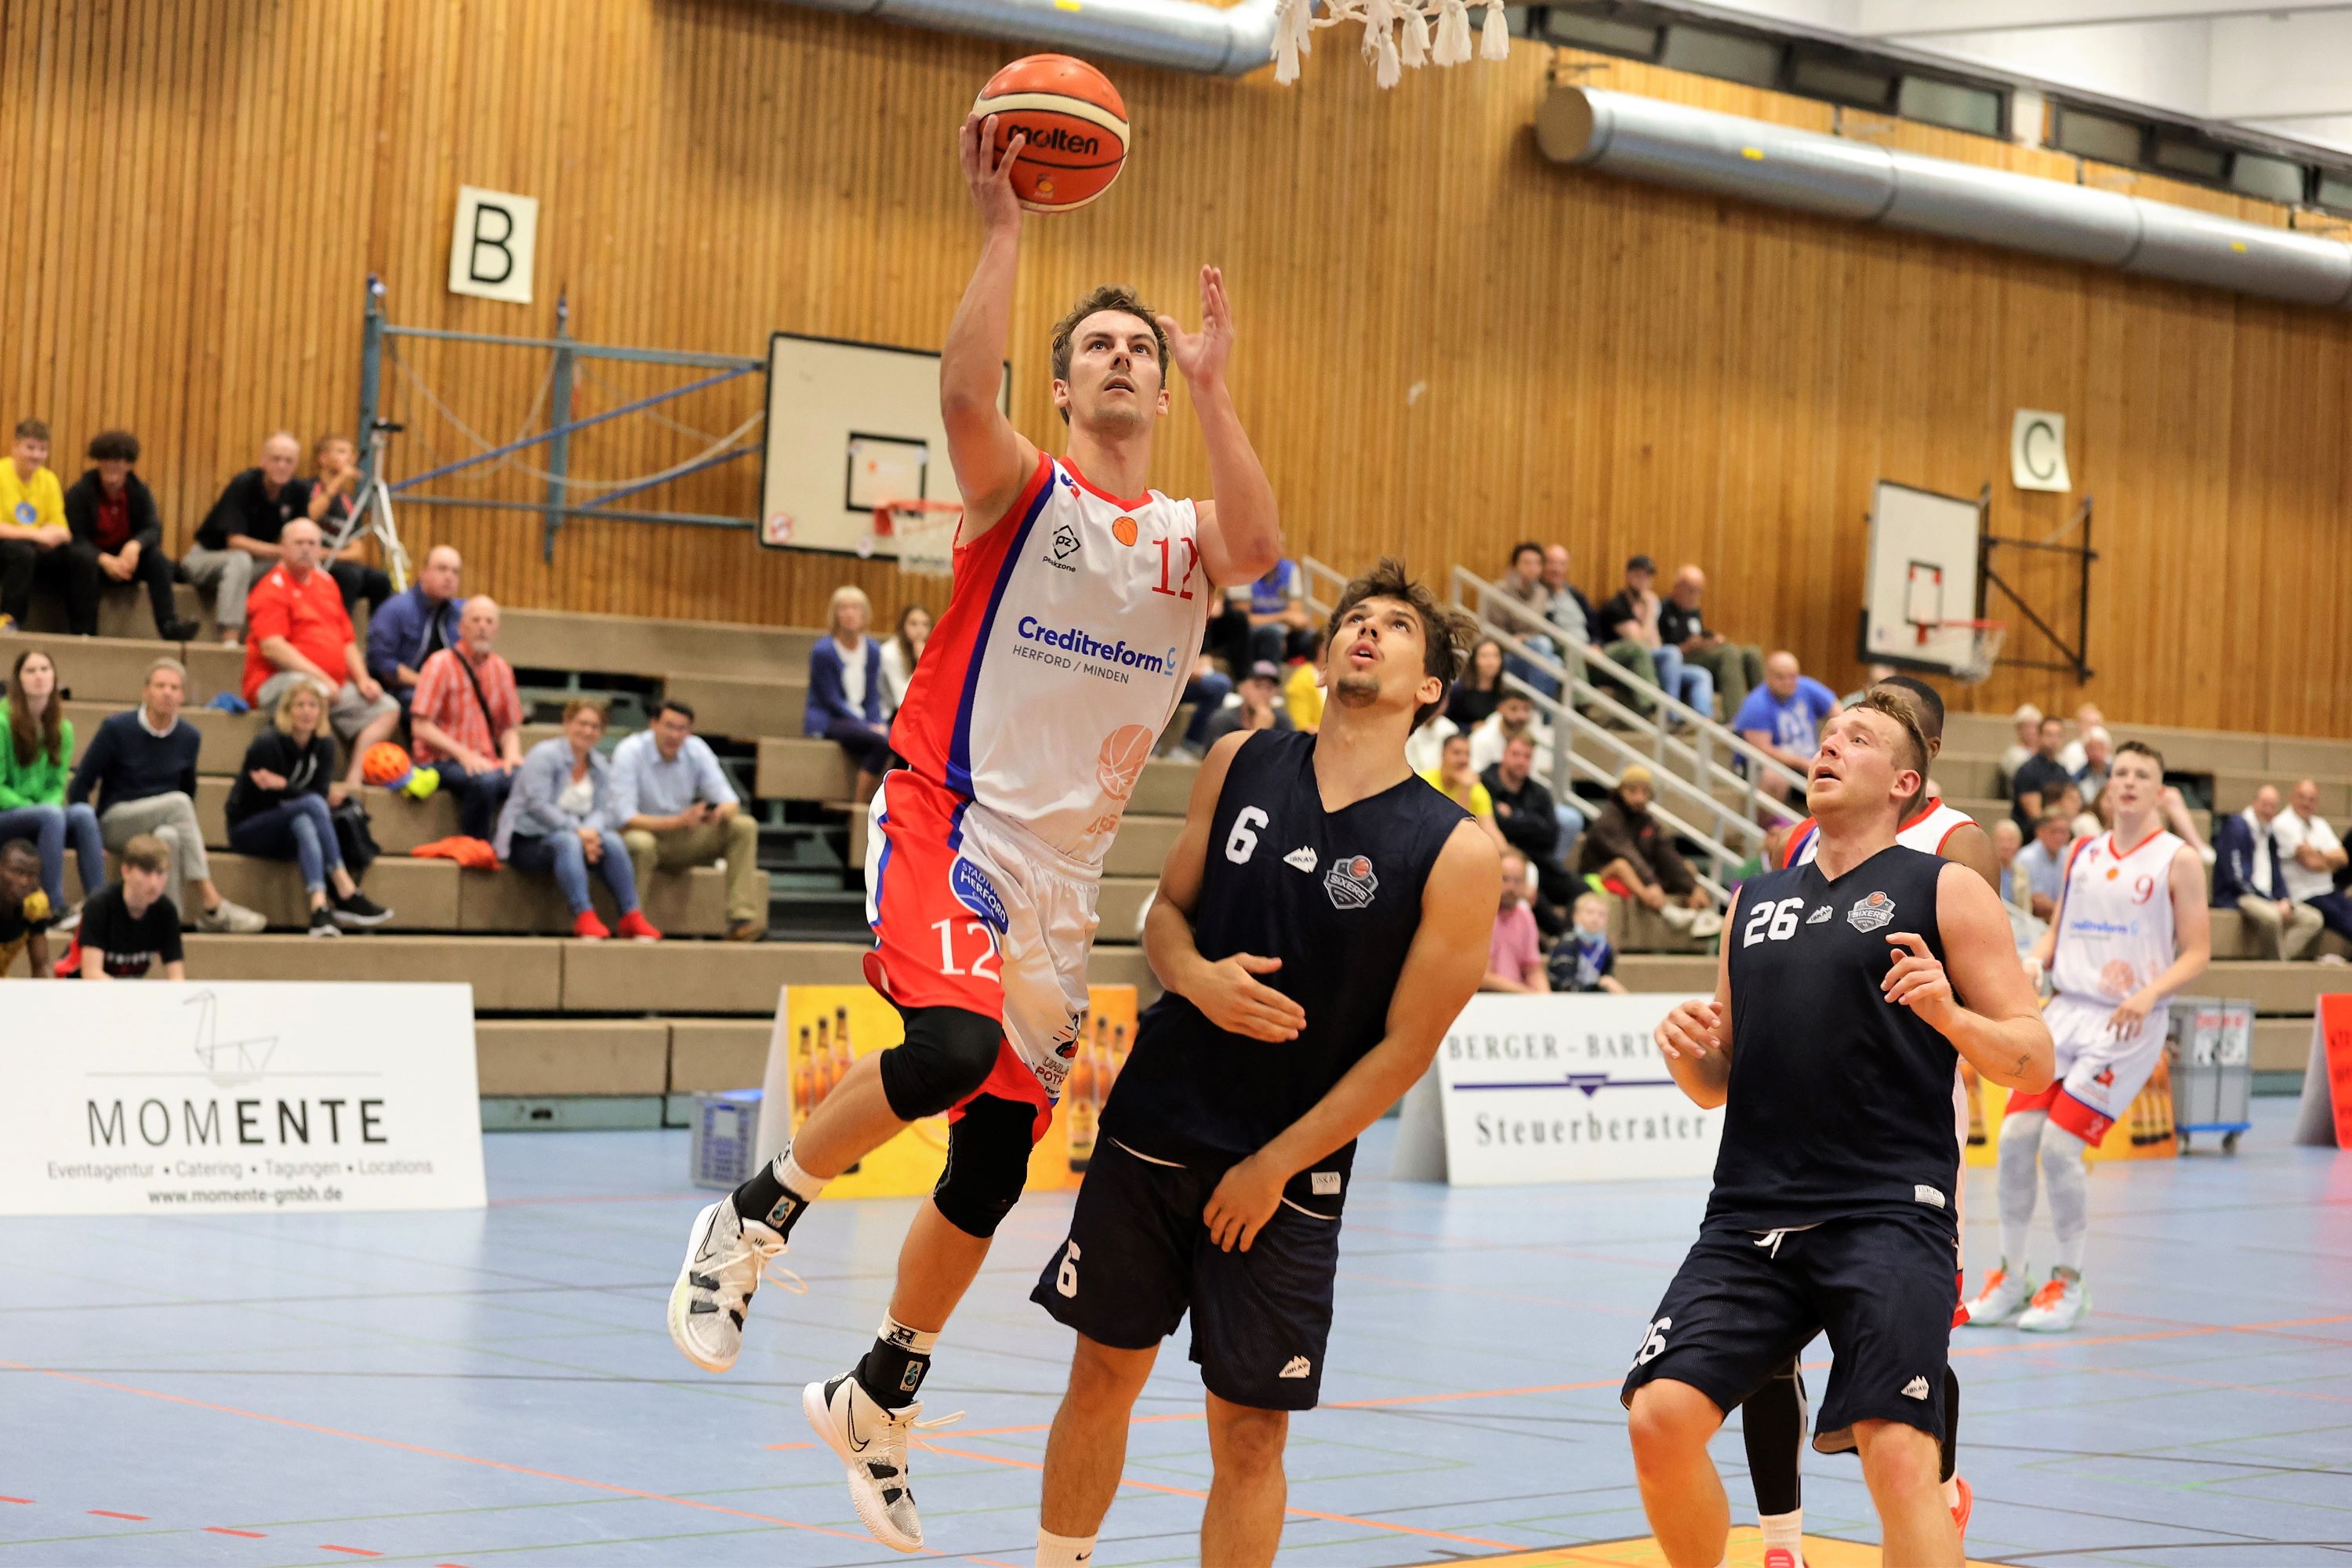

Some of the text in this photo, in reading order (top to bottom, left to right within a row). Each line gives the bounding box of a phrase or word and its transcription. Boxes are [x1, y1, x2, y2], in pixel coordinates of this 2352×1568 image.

[1007, 124, 1099, 156] molten
[470, 203, 513, 284] B
[2023, 419, 2056, 481] C
[1152, 537, 1199, 601] 12
[1013, 644, 1071, 669] HERFORD
[1083, 663, 1130, 684] MINDEN
[1018, 616, 1163, 673] Creditreform
[1225, 805, 1269, 865] 6
[960, 870, 1006, 923] HERFORD
[1330, 874, 1368, 901] SIXERS
[2131, 875, 2154, 906] 9
[1744, 897, 1805, 949] 26
[1852, 909, 1888, 920] SIXERS
[931, 918, 1000, 985] 12
[1043, 1055, 1070, 1075] UHL
[1449, 1033, 1559, 1060] BERGER
[1585, 1032, 1656, 1058] BART
[87, 1098, 388, 1147] MOMENTE
[1476, 1112, 1705, 1145] Steuerberater
[47, 1158, 434, 1181] Eventagentur Catering Tagungen Locations
[147, 1185, 343, 1205] www.momente-gmbh.de
[1056, 1238, 1081, 1298] 6
